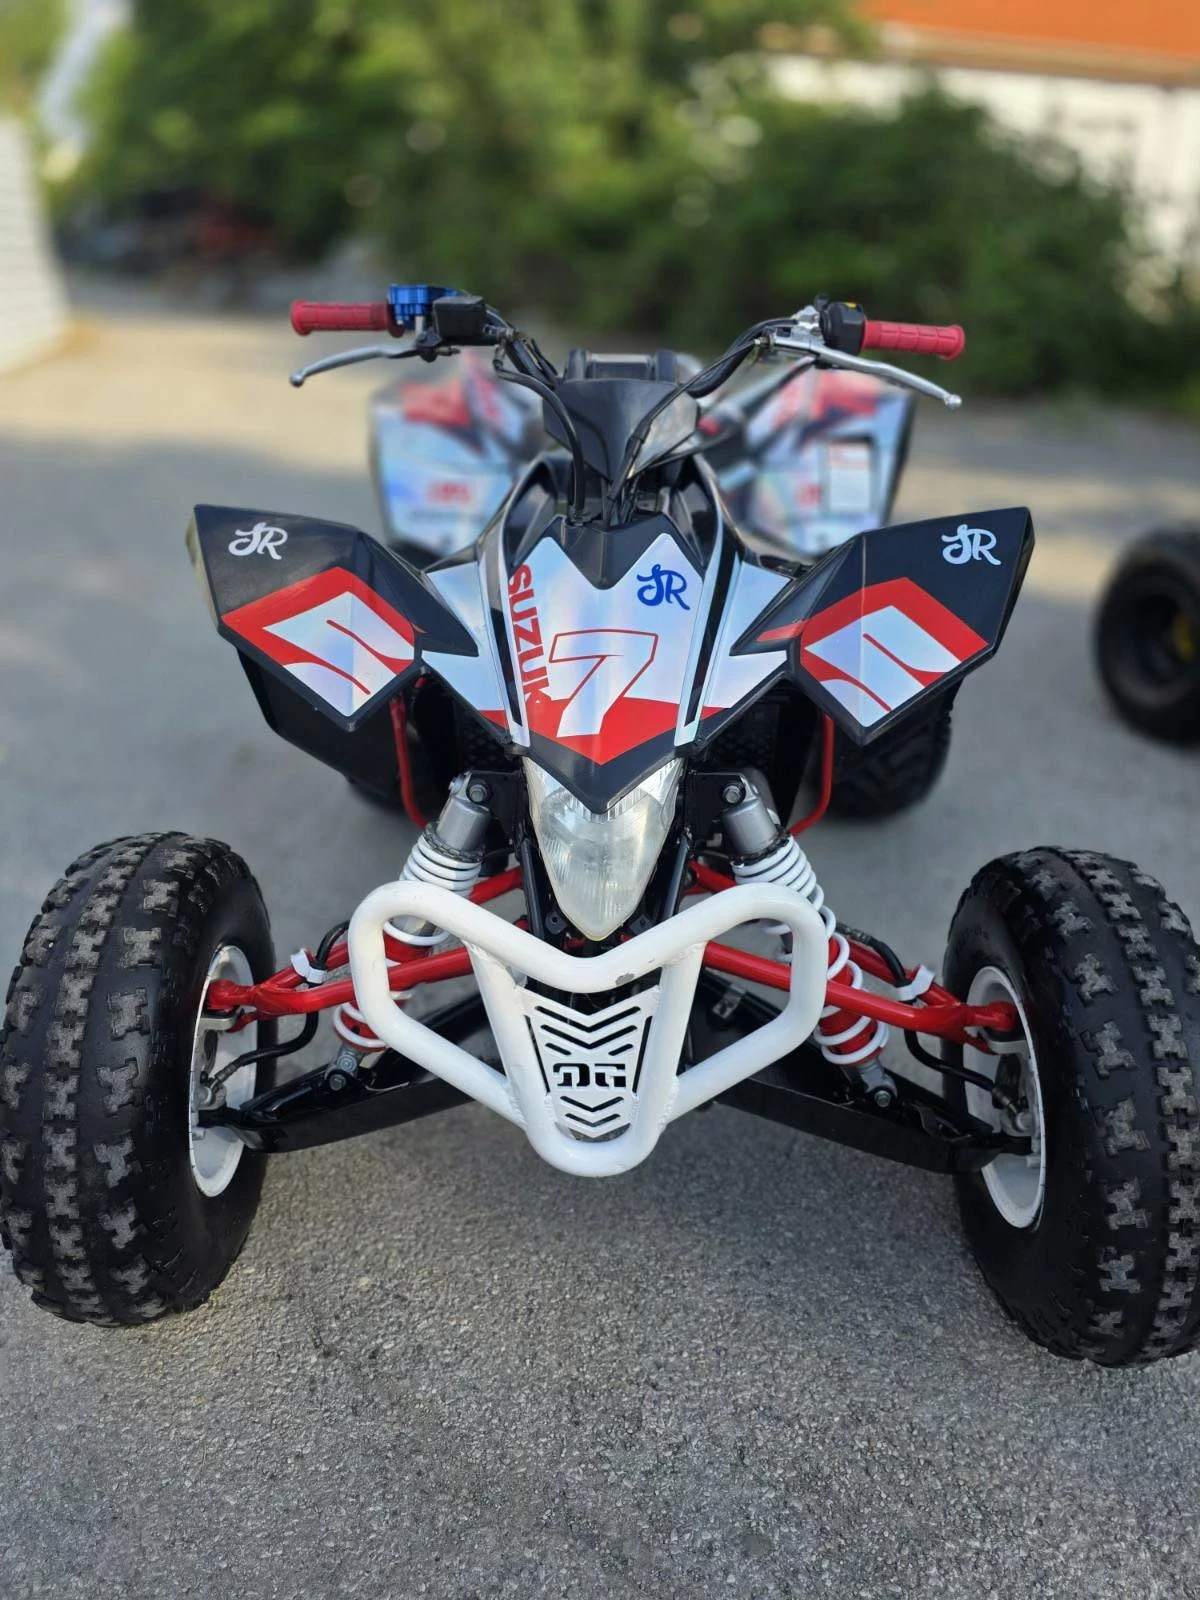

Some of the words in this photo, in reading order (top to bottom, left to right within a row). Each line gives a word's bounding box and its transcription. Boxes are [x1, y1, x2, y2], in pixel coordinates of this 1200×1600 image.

[228, 521, 288, 560] JR
[941, 524, 1001, 566] JR
[637, 564, 690, 610] JR
[508, 564, 552, 706] SUZUK
[549, 628, 658, 737] 7
